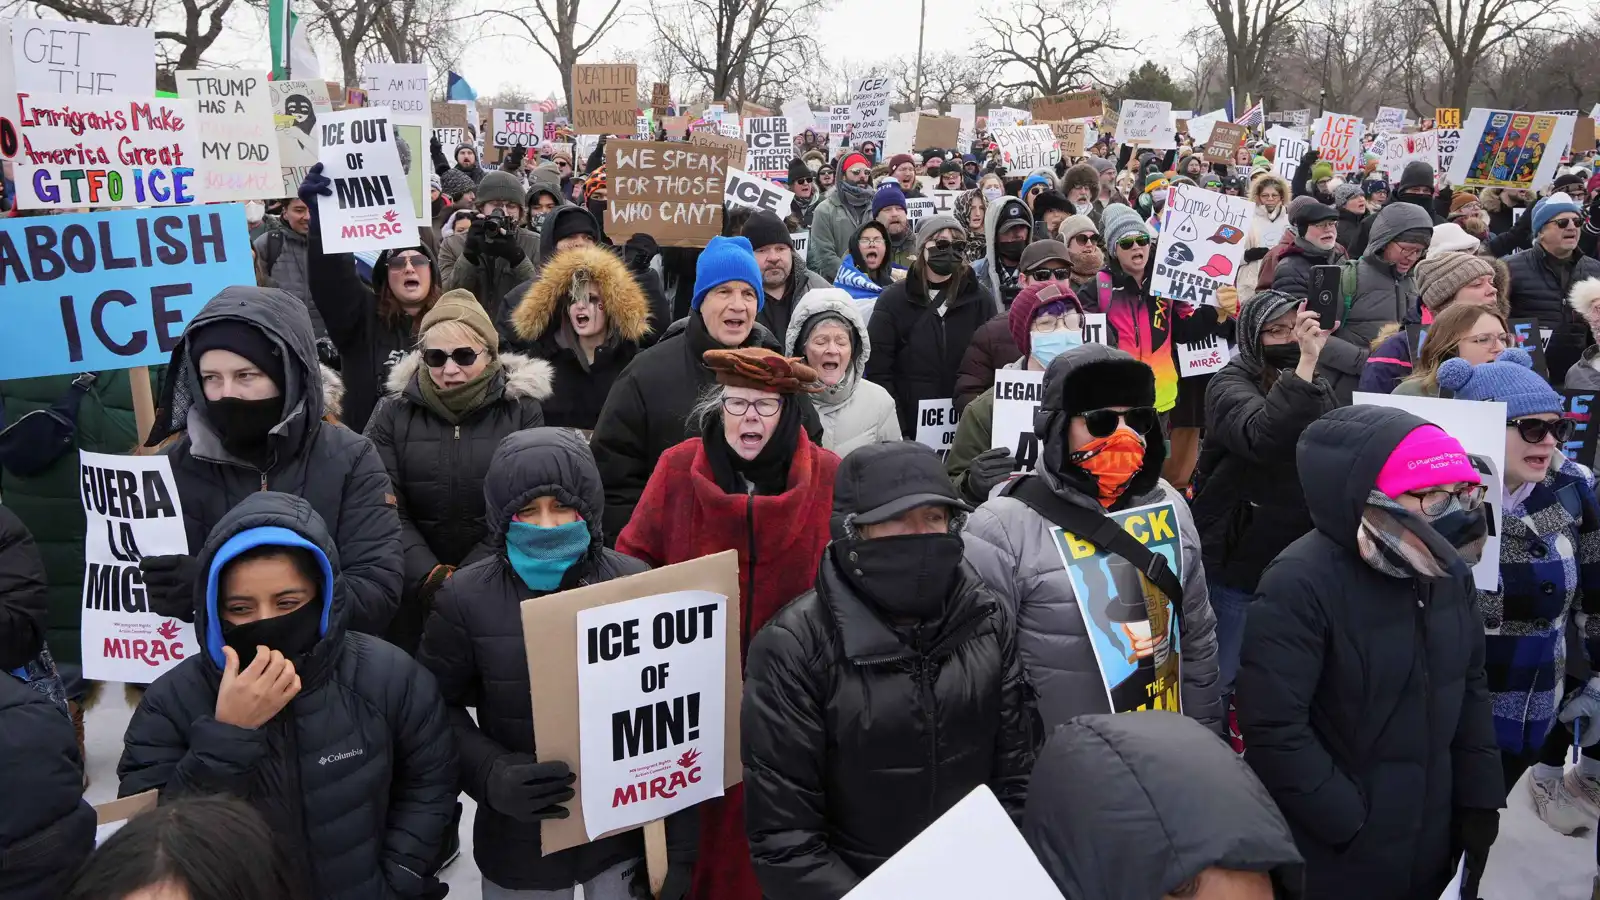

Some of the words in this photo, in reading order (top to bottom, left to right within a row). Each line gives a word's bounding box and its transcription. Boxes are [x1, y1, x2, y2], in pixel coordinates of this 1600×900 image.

[24, 28, 90, 67] GET
[368, 77, 380, 91] I
[388, 79, 404, 91] AM
[407, 78, 428, 91] NOT
[577, 66, 619, 85] DEATH
[623, 66, 637, 86] TO
[859, 79, 888, 92] ICE!
[187, 78, 256, 97] TRUMP
[579, 88, 630, 104] WHITE
[18, 94, 127, 136] Immigrants
[130, 101, 185, 132] Make
[199, 100, 225, 114] HAS
[234, 102, 245, 113] A
[833, 107, 850, 115] ICE
[861, 108, 878, 120] YOU
[505, 112, 532, 123] ICE
[750, 118, 787, 133] KILLER
[863, 120, 875, 128] ONE
[1326, 116, 1356, 135] ICE
[1438, 110, 1458, 124] ICE
[321, 122, 345, 148] ICE
[351, 118, 388, 144] OUT
[505, 122, 535, 133] KILLS
[831, 123, 846, 133] MPL
[1058, 125, 1083, 134] NICE
[495, 132, 540, 147] GOOD
[746, 133, 791, 148] ICE
[995, 128, 1034, 148] BRING
[1321, 132, 1352, 148] OUT
[23, 134, 110, 165] America
[118, 136, 183, 166] Great
[203, 142, 231, 160] MY
[238, 142, 269, 162] DAD
[1017, 142, 1043, 154] HEAT
[1208, 147, 1233, 158] CITY
[346, 152, 364, 170] OF
[617, 149, 657, 173] WE
[662, 151, 725, 176] SPEAK
[1010, 153, 1036, 171] MELT
[1280, 163, 1298, 181] IC
[33, 168, 123, 203] GTFO
[132, 167, 195, 204] ICE
[334, 175, 396, 210] MN!
[615, 177, 647, 196] FOR
[653, 176, 722, 195] THOSE
[726, 176, 783, 214] ICE
[611, 201, 653, 225] WHO
[659, 199, 724, 224] CAN'T
[908, 201, 934, 209] ALIZATION
[911, 209, 923, 218] FOR
[1174, 184, 1211, 219] Same
[1214, 194, 1248, 228] Shit
[341, 222, 403, 239] MIRAC
[0, 212, 227, 286] ABOLISH
[1169, 280, 1213, 304] HAT
[60, 283, 192, 362] ICE
[1189, 357, 1222, 369] MIRAC
[921, 412, 943, 427] ICE
[82, 463, 177, 520] FUERA
[107, 519, 142, 562] LA
[86, 562, 151, 614] MIG
[587, 618, 640, 665] ICE
[652, 602, 718, 650] OUT
[103, 637, 185, 667] MIRAC
[641, 662, 670, 693] OF
[1145, 676, 1165, 698] THE
[1124, 680, 1179, 713] AN
[612, 691, 701, 762] MN!
[327, 749, 364, 763] Columbia
[612, 766, 703, 808] MIRAC
